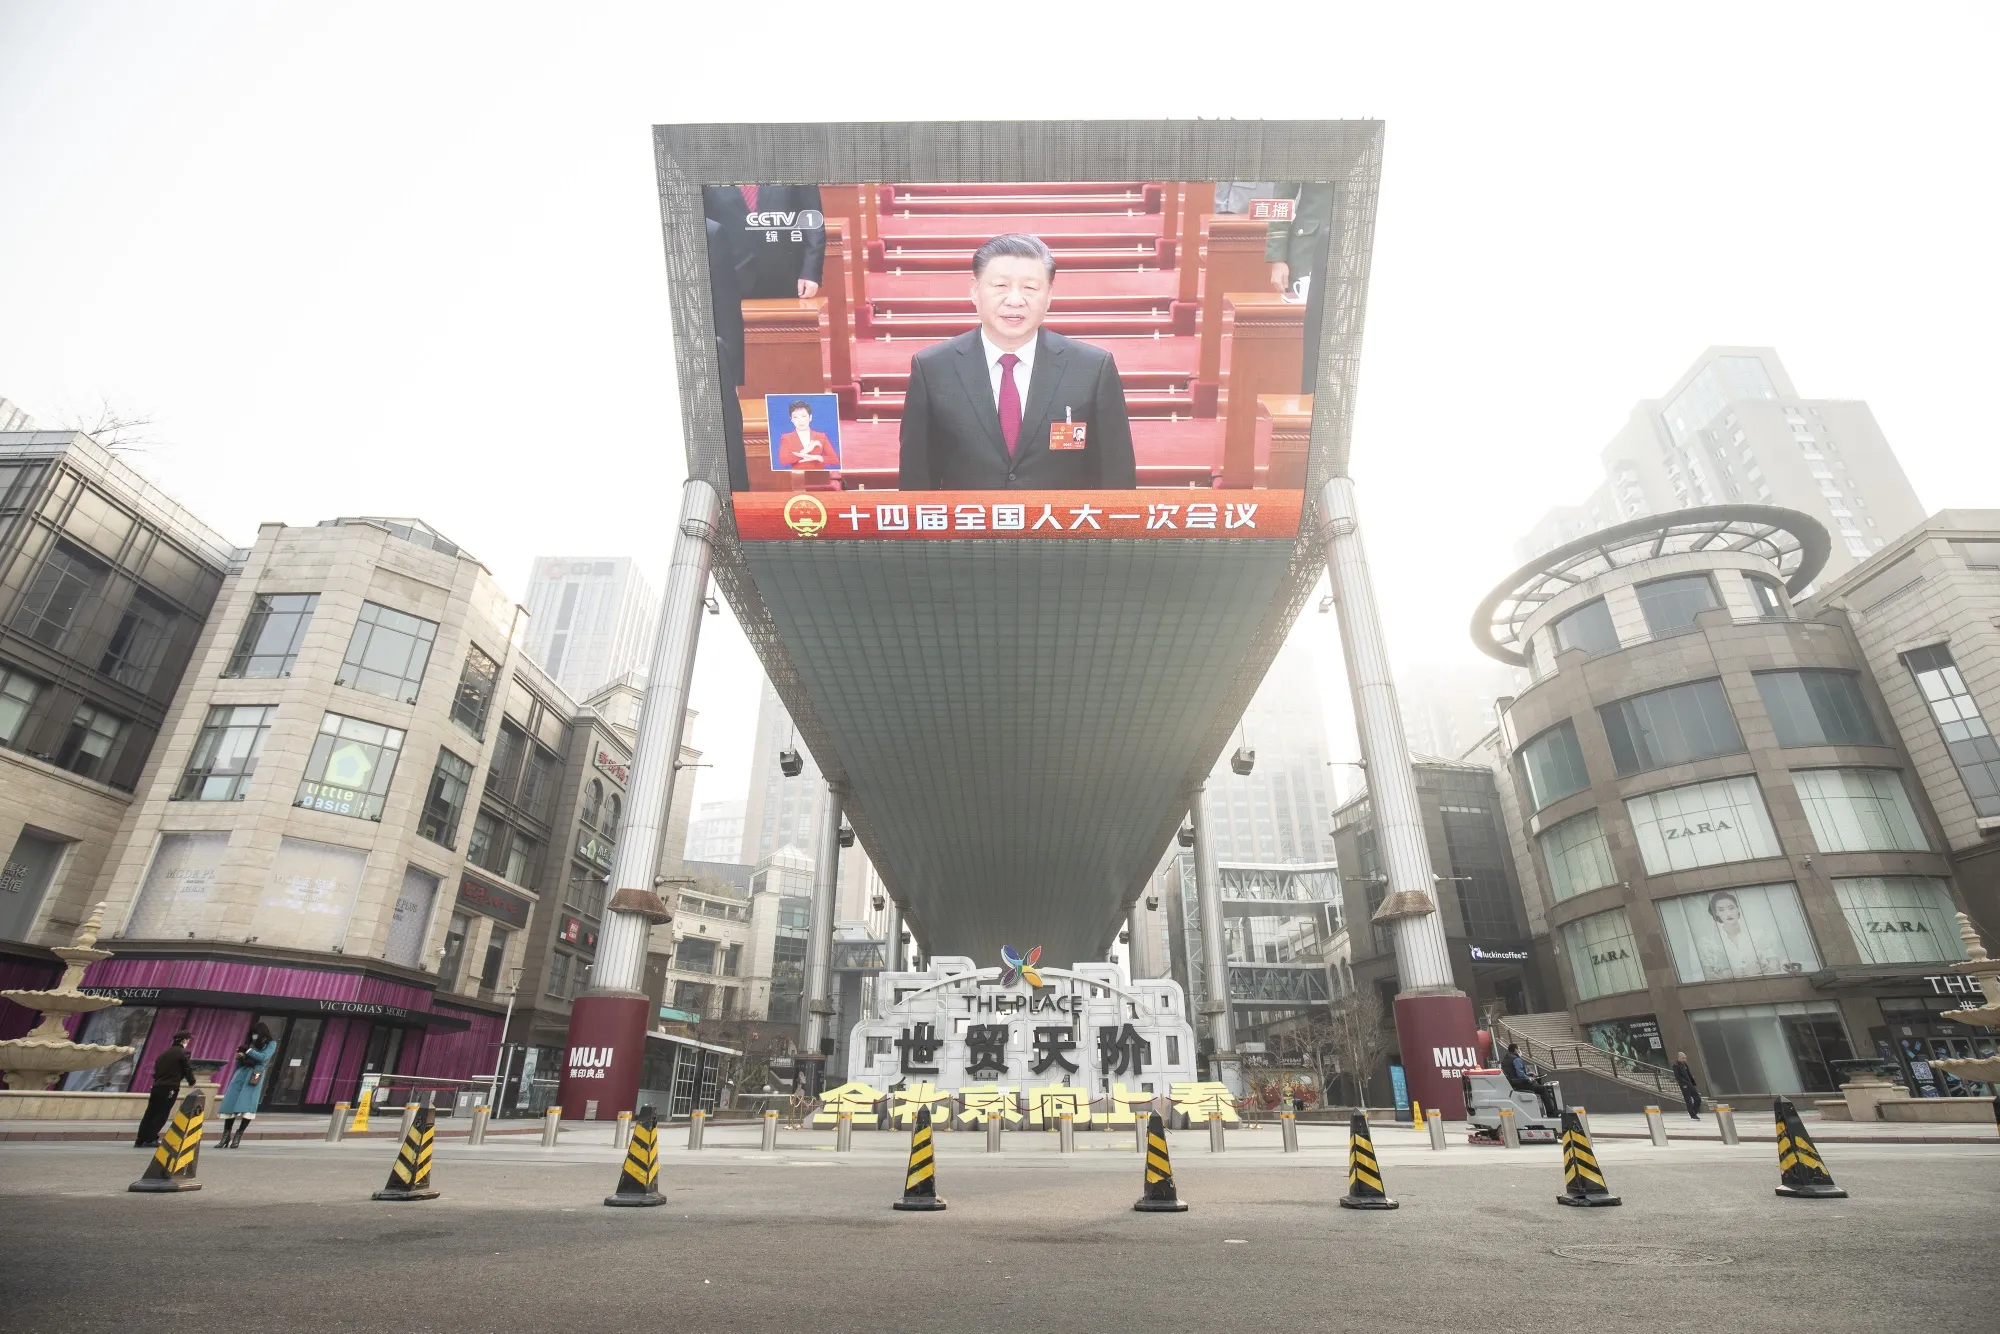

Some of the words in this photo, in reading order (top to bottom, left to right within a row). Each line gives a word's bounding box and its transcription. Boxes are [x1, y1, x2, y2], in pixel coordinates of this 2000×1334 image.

[1254, 202, 1289, 218] 直播
[746, 212, 796, 227] CCTV
[766, 231, 803, 243] 综合
[838, 503, 1259, 530] 十四届全国人大一次会议
[307, 783, 354, 801] little
[303, 796, 350, 813] oasis
[1666, 821, 1732, 840] ZARA
[1866, 921, 1929, 933] ZARA
[1592, 949, 1630, 965] ZARA
[122, 988, 161, 998] SECRET
[1923, 975, 1983, 994] THE
[319, 1001, 383, 1014] VICTORIA'S
[385, 1006, 407, 1018] SECRET
[962, 995, 1006, 1013] THE
[1016, 994, 1082, 1013] PLACE
[569, 1047, 613, 1067] MUJI
[894, 1023, 1151, 1076] 世贸天阶
[1433, 1047, 1477, 1067] MUJI
[570, 1068, 604, 1079] 無印良品
[812, 1082, 1242, 1124] 全北京向上看
